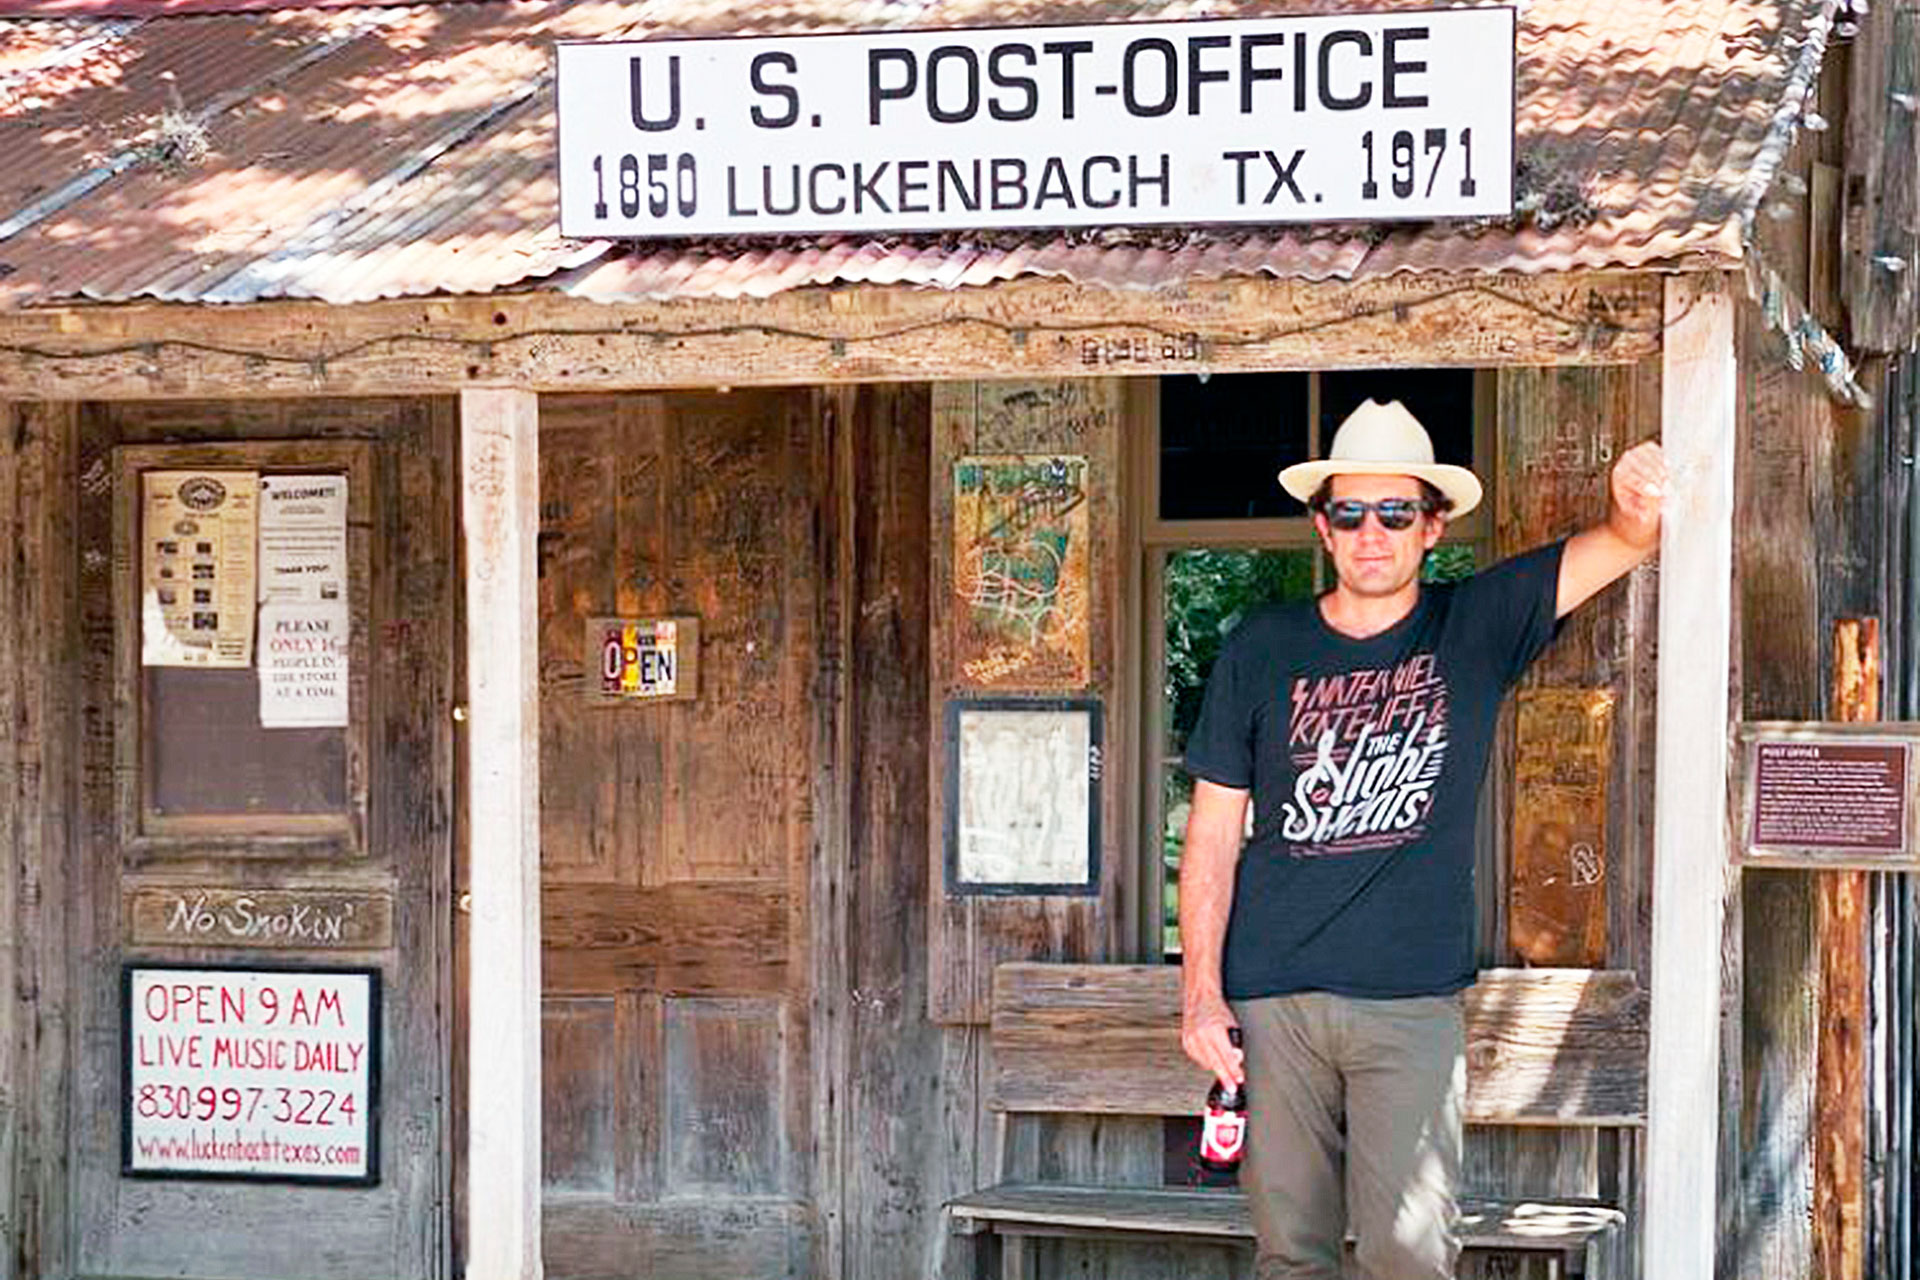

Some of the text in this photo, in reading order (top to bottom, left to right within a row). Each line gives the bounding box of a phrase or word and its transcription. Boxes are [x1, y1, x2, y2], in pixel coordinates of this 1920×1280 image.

[627, 27, 1432, 132] U. S. POST-OFFICE
[592, 127, 1477, 220] 1850 LUCKENBACH TX. 1971
[270, 638, 315, 653] ONLY
[276, 620, 330, 633] PLEASE
[604, 640, 672, 684] OPEN
[1366, 733, 1403, 756] THE
[167, 897, 217, 932] No
[145, 984, 344, 1027] OPEN 9 AM
[139, 1035, 364, 1073] LIVE MUSIC DAILY
